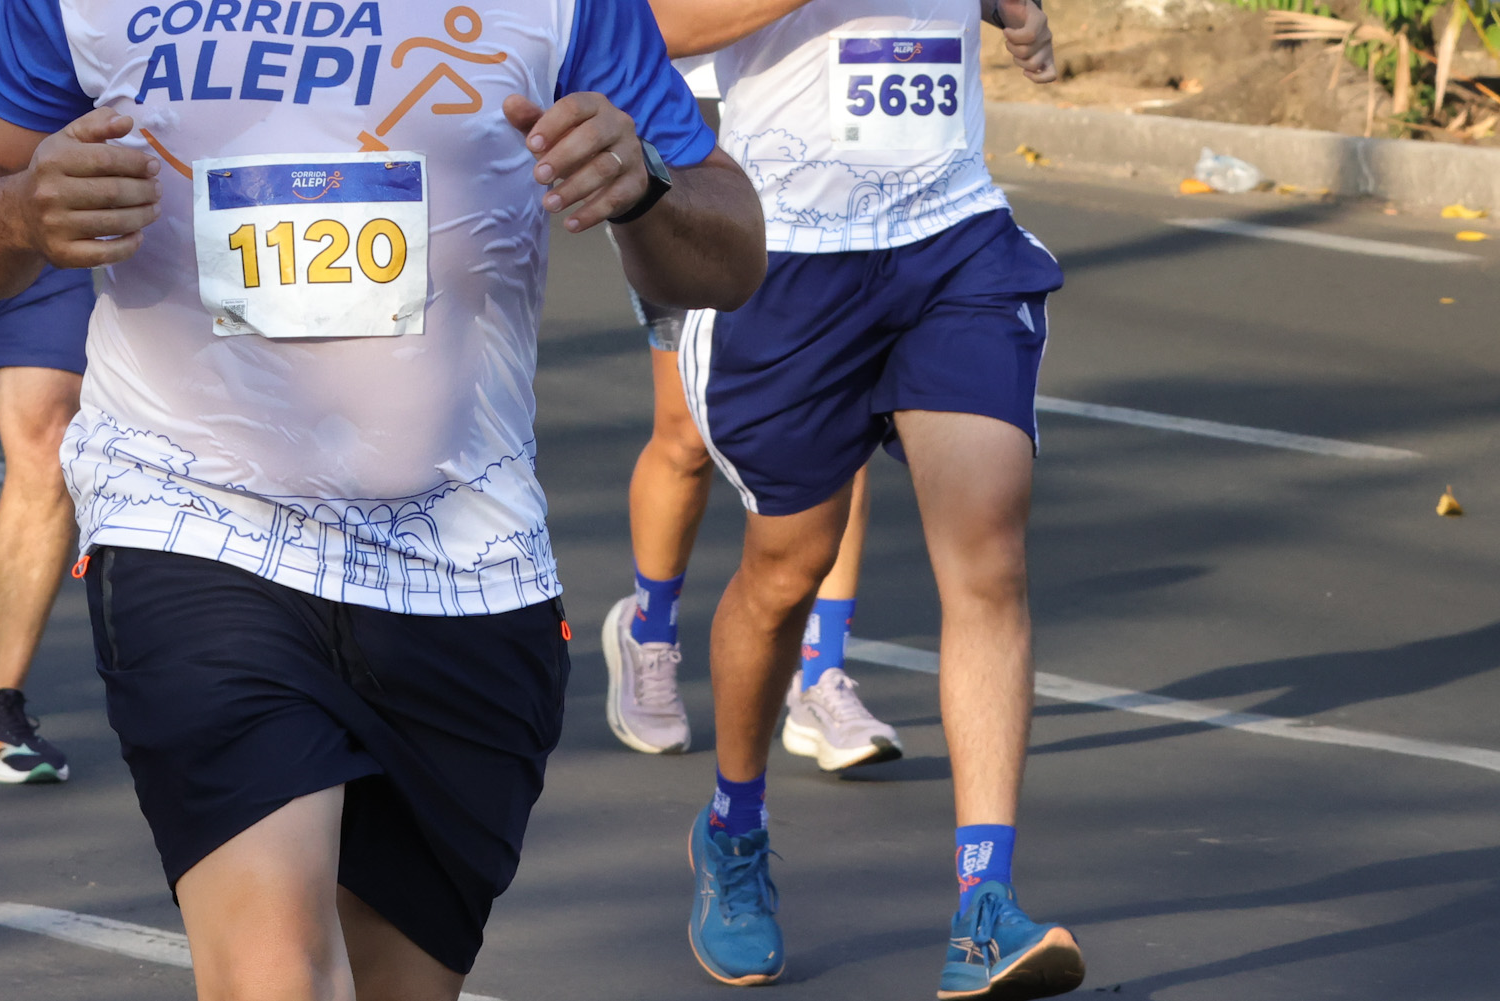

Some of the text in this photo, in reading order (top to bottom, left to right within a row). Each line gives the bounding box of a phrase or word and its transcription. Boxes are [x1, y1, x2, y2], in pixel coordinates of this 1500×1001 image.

[134, 40, 383, 106] ALEPI
[846, 74, 958, 116] 5633
[292, 178, 327, 187] ALEPI
[228, 217, 408, 288] 1120
